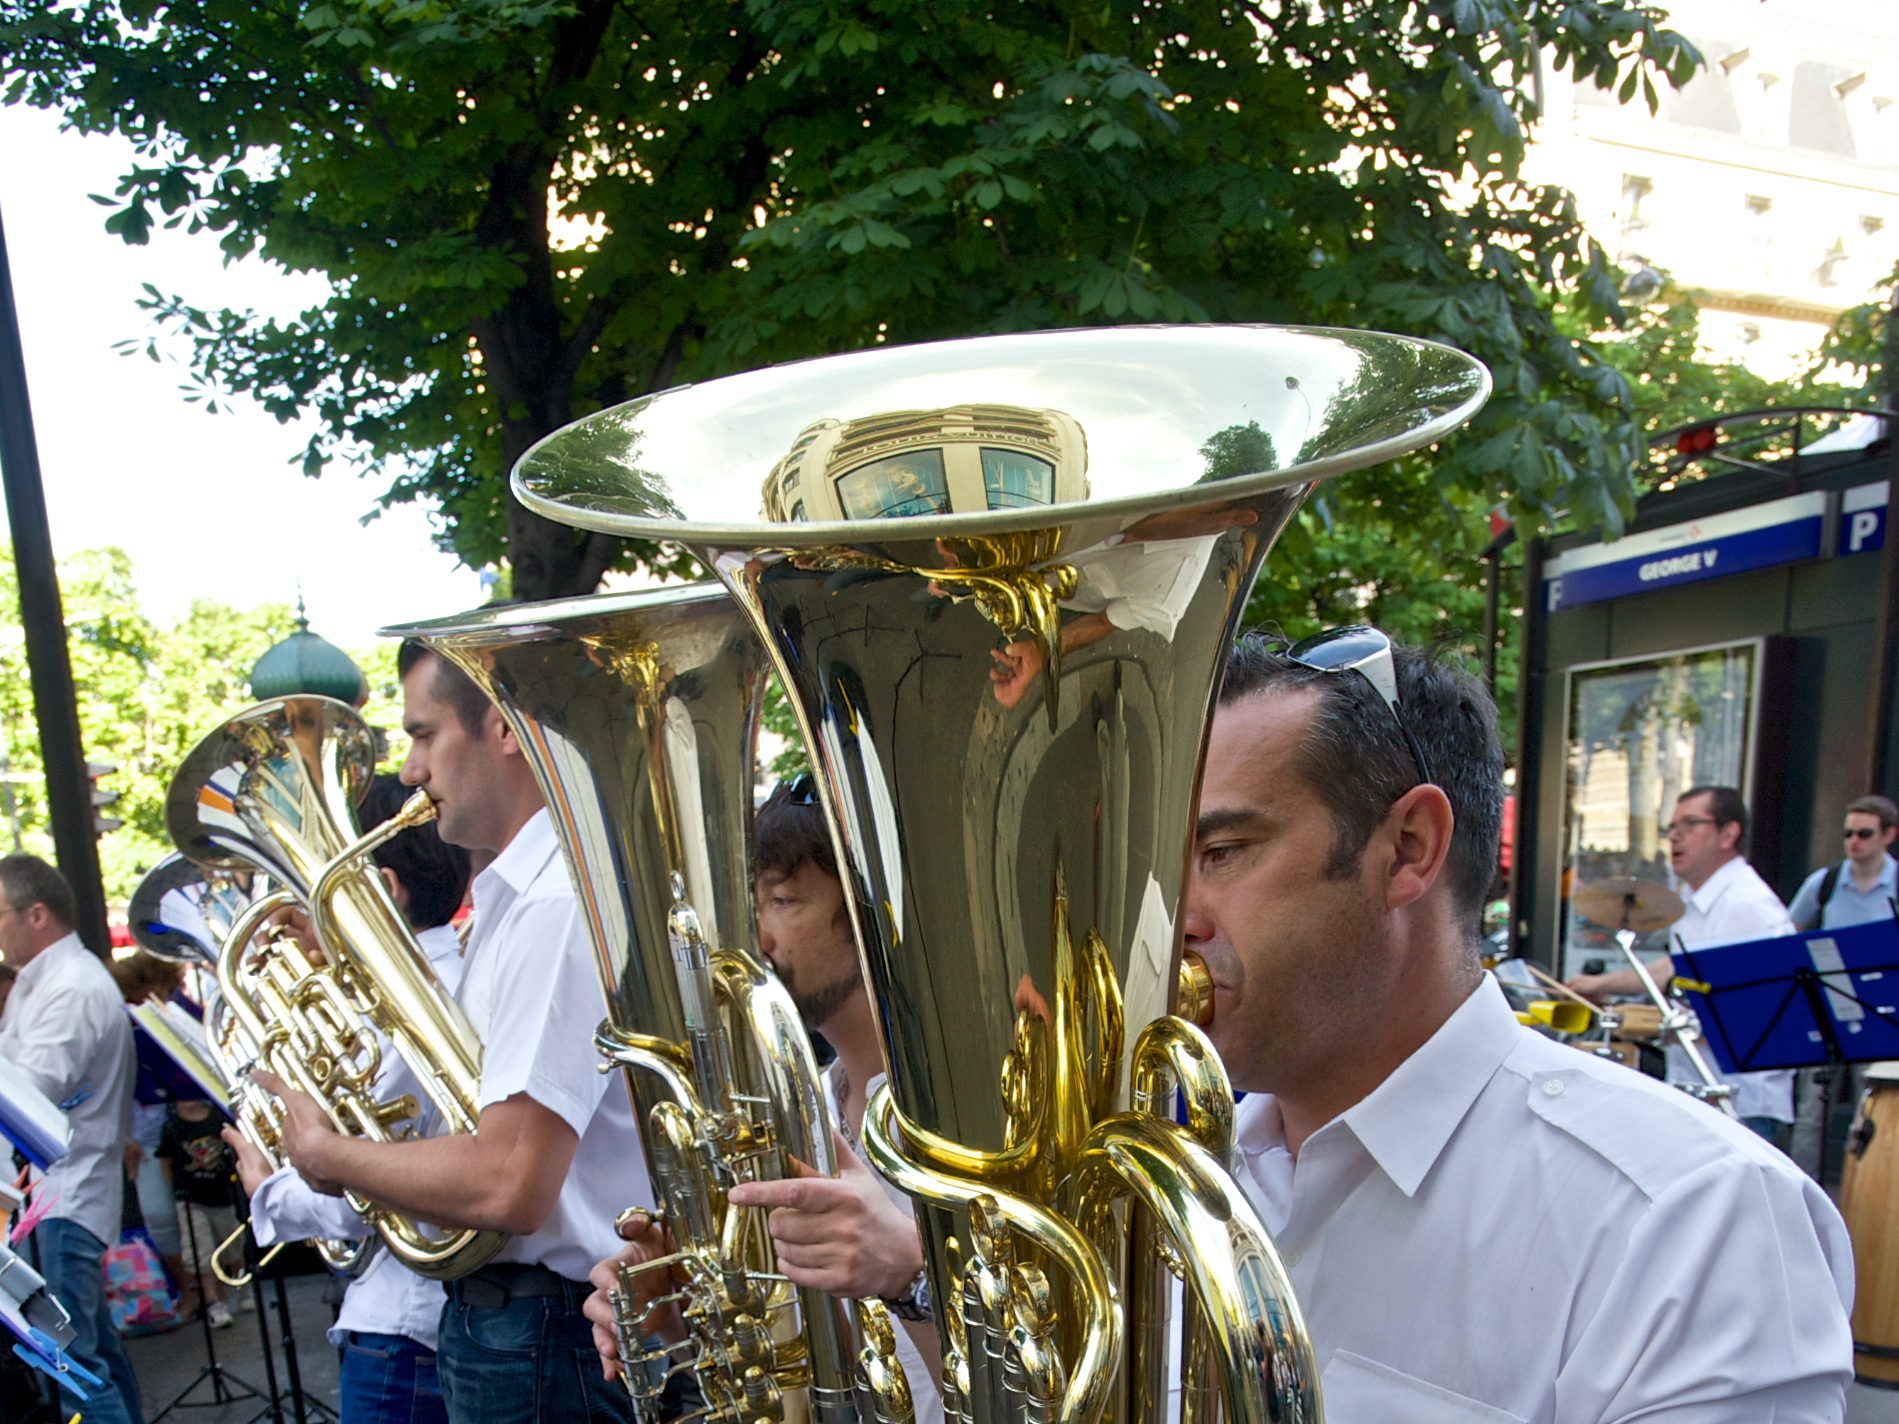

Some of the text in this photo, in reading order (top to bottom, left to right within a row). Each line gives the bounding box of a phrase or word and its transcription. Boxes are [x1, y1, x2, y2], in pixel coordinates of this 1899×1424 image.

[1850, 511, 1879, 551] P
[1638, 548, 1718, 581] GEORGE V
